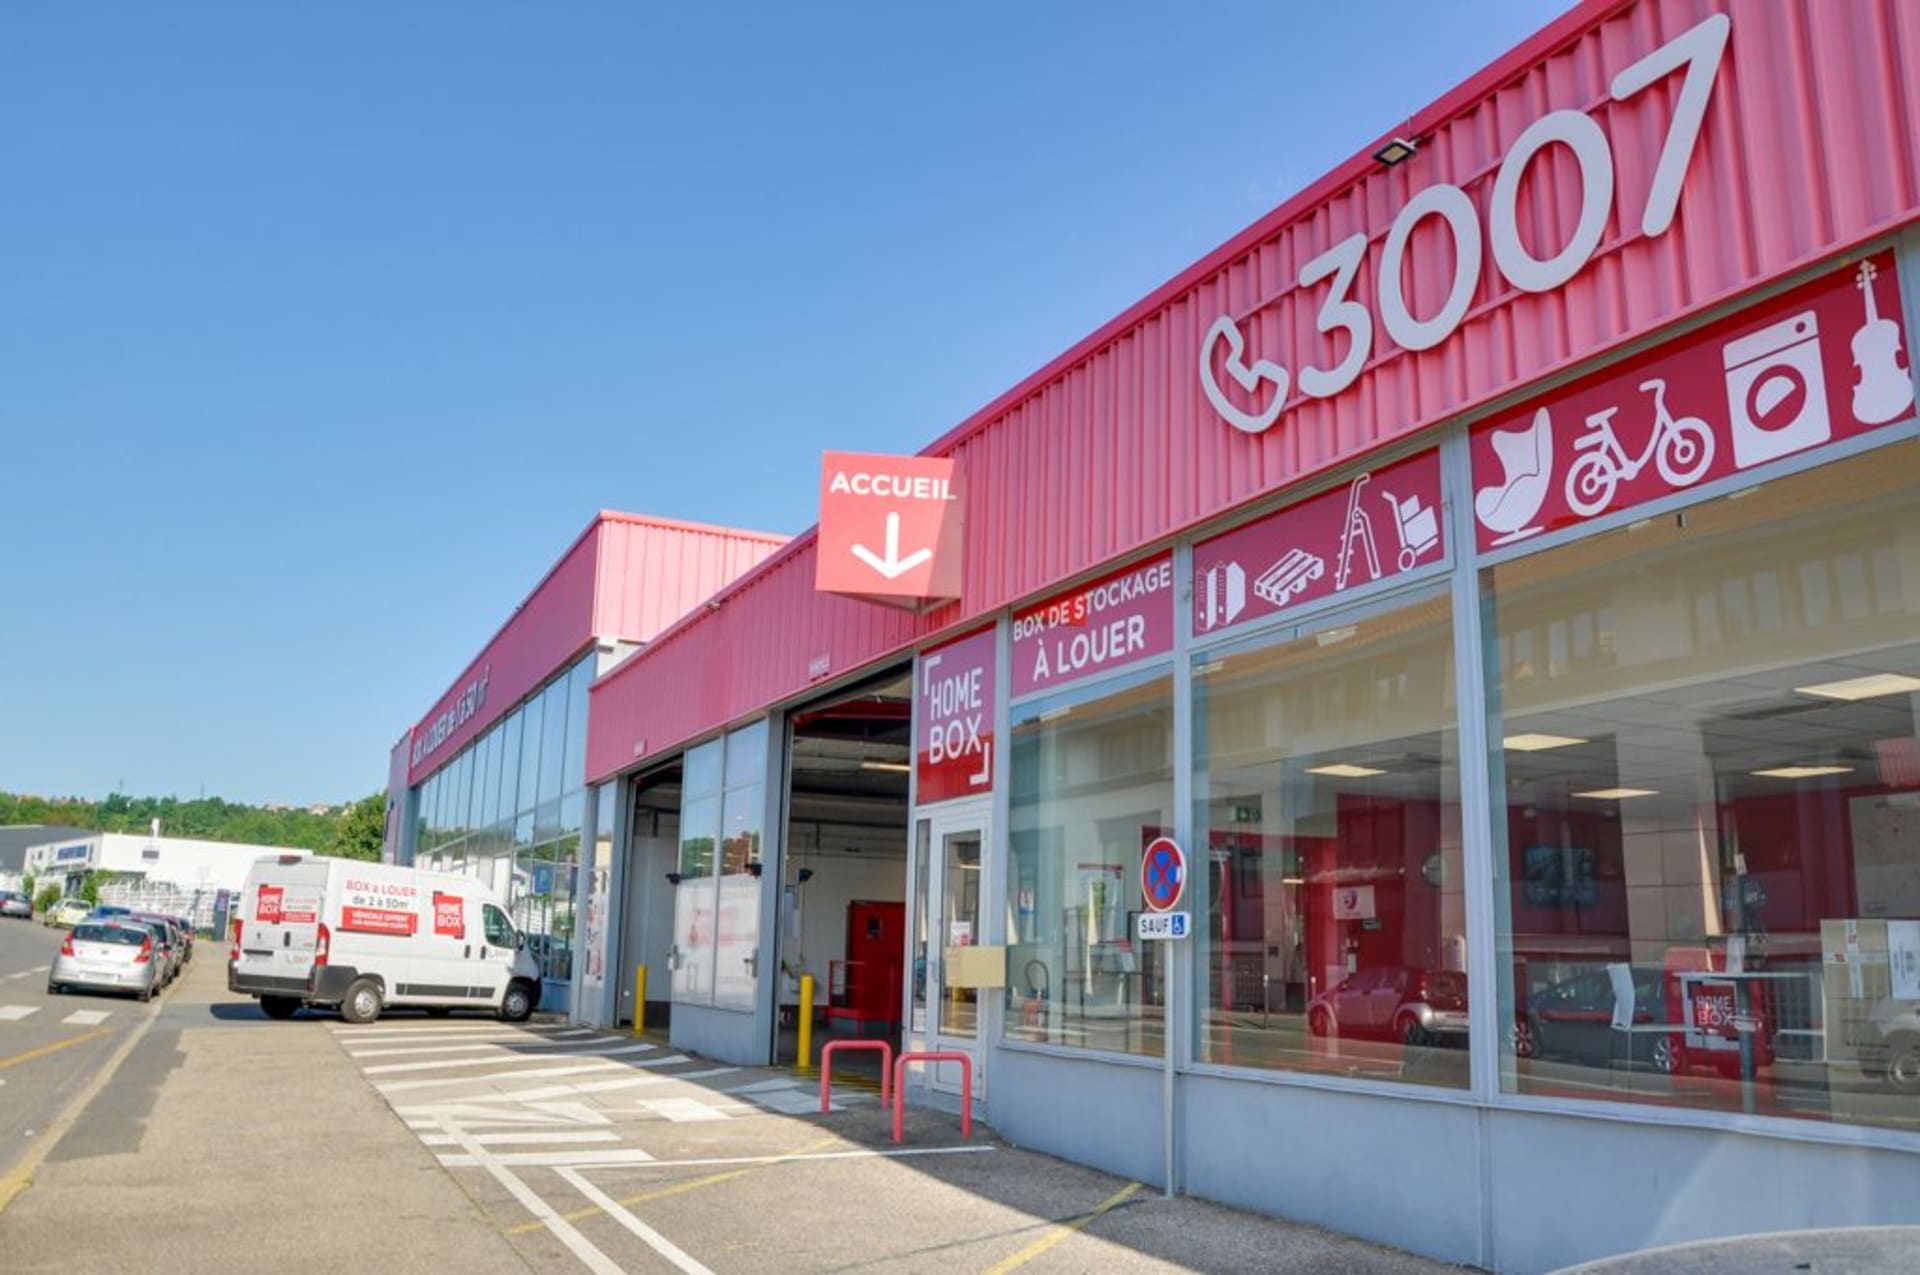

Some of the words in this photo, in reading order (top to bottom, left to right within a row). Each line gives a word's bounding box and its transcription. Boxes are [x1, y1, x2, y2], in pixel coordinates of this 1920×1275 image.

[1299, 13, 1730, 398] 3007
[829, 471, 957, 500] ACCUEIL
[1013, 610, 1045, 643] BOX
[1048, 601, 1070, 629] DE
[1074, 562, 1171, 620] STOCKAGE
[1032, 637, 1050, 683] À
[1057, 614, 1145, 675] LOUER
[930, 667, 983, 721] HOME
[929, 712, 982, 765] BOX
[346, 879, 369, 893] BOX
[382, 884, 416, 897] LOUER
[259, 903, 280, 915] BOX
[353, 896, 365, 905] de
[369, 896, 375, 906] 2
[437, 913, 460, 928] BOX
[1142, 917, 1169, 932] SAUF
[1696, 994, 1731, 1011] HOME
[1698, 1010, 1733, 1026] BOX
